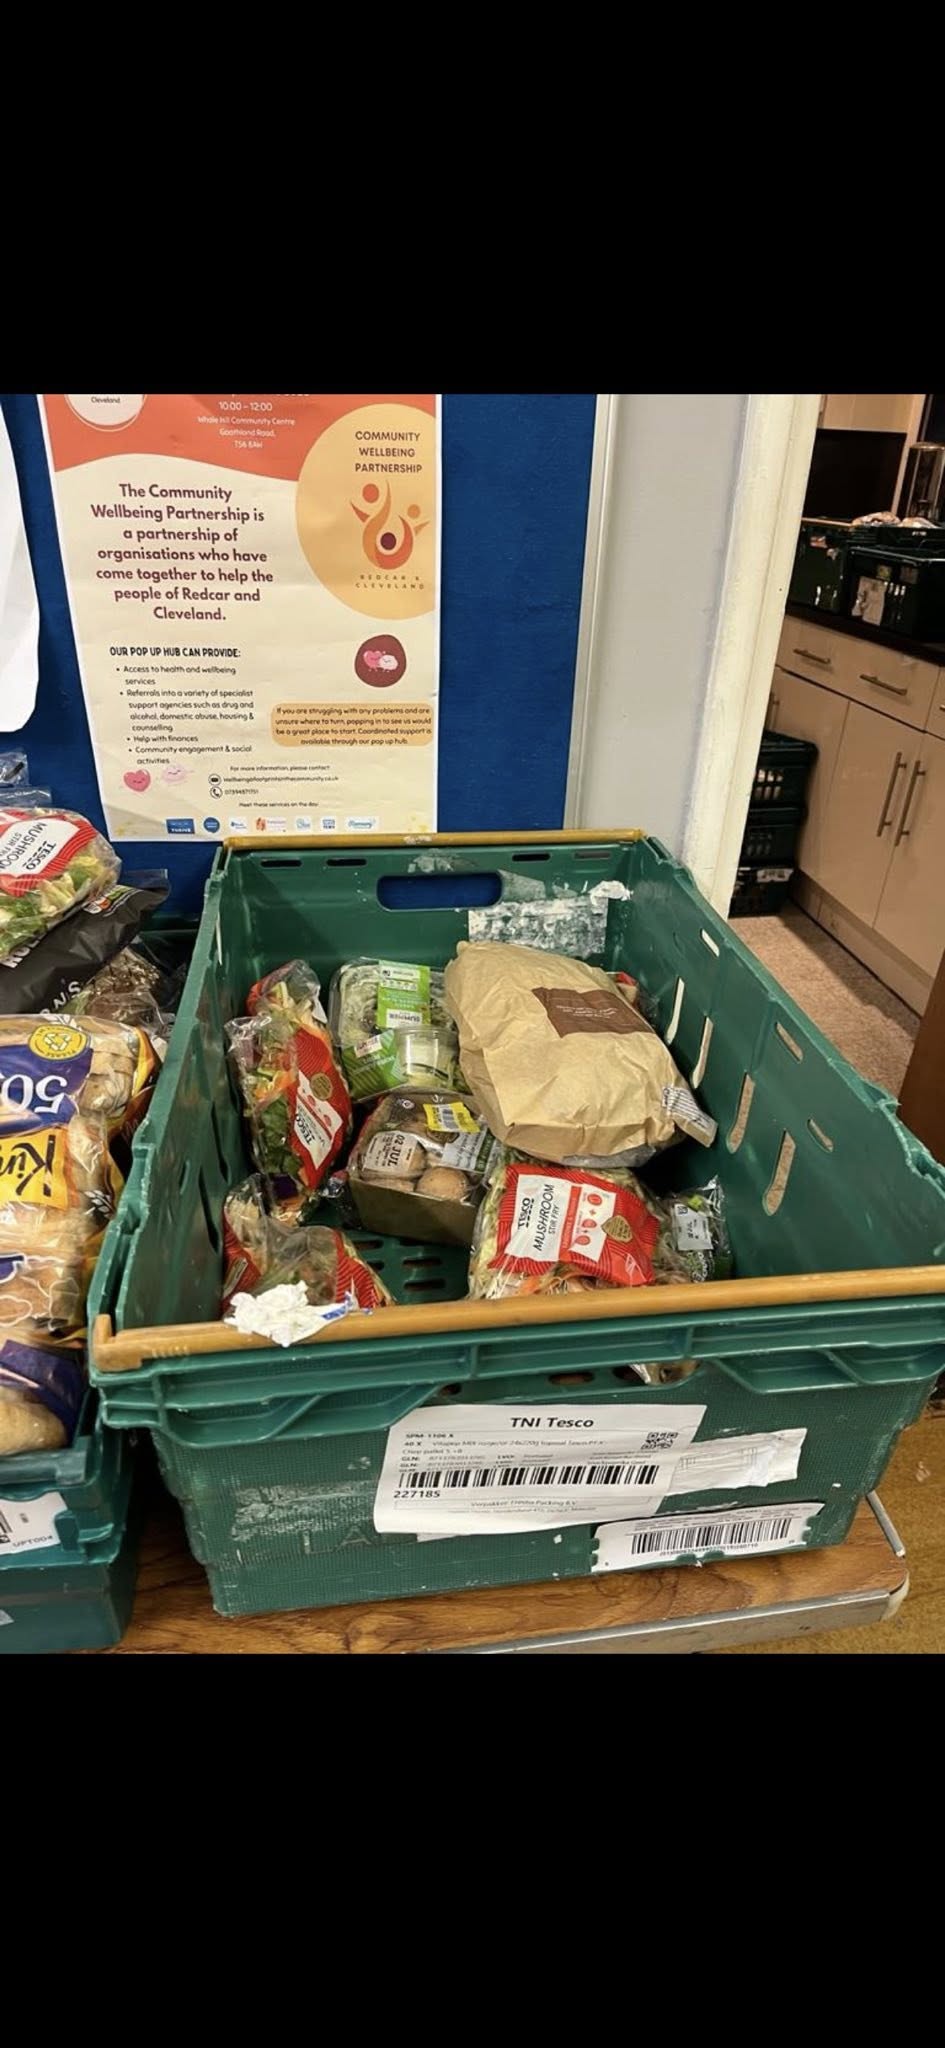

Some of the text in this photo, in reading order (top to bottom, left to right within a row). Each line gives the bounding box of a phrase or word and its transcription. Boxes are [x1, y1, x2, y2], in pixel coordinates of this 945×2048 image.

[219, 402, 242, 410] 10:00
[250, 402, 272, 411] 12:00
[231, 417, 271, 425] Community
[355, 431, 420, 441] COMMUNITY
[359, 447, 415, 457] WELLBEING
[355, 463, 422, 473] PARTNERSHIP
[119, 484, 232, 502] The Community
[91, 504, 264, 524] Wellbeing Partnership is
[123, 527, 238, 544] a partnership of
[98, 547, 267, 562] organisations who have
[96, 567, 273, 584] come together to help the
[114, 586, 260, 602] people of Redcar and
[153, 606, 226, 620] Cleveland.
[110, 647, 241, 657] OUR POP UP HUB CAN PROVIDE:
[202, 666, 236, 675] wellbeing
[184, 690, 209, 698] variety
[220, 690, 253, 698] specialist
[129, 702, 158, 710] support
[160, 702, 192, 710] agencies
[222, 701, 239, 709] drug
[309, 708, 342, 716] struggling
[372, 707, 403, 715] problems
[220, 713, 248, 721] housing
[346, 718, 374, 726] popping
[132, 724, 173, 732] counselling
[311, 728, 330, 736] place
[400, 728, 425, 736] support
[134, 735, 150, 743] Help
[331, 738, 358, 746] through
[135, 746, 177, 754] Community
[178, 746, 224, 754] engagement
[25, 842, 57, 870] TESCO
[0, 1074, 68, 1114] 50
[387, 1134, 405, 1167] 02 JUL
[0, 1134, 56, 1198] Kin
[533, 1183, 555, 1251] MUSHROOM
[511, 1417, 594, 1428] TNI Tesco
